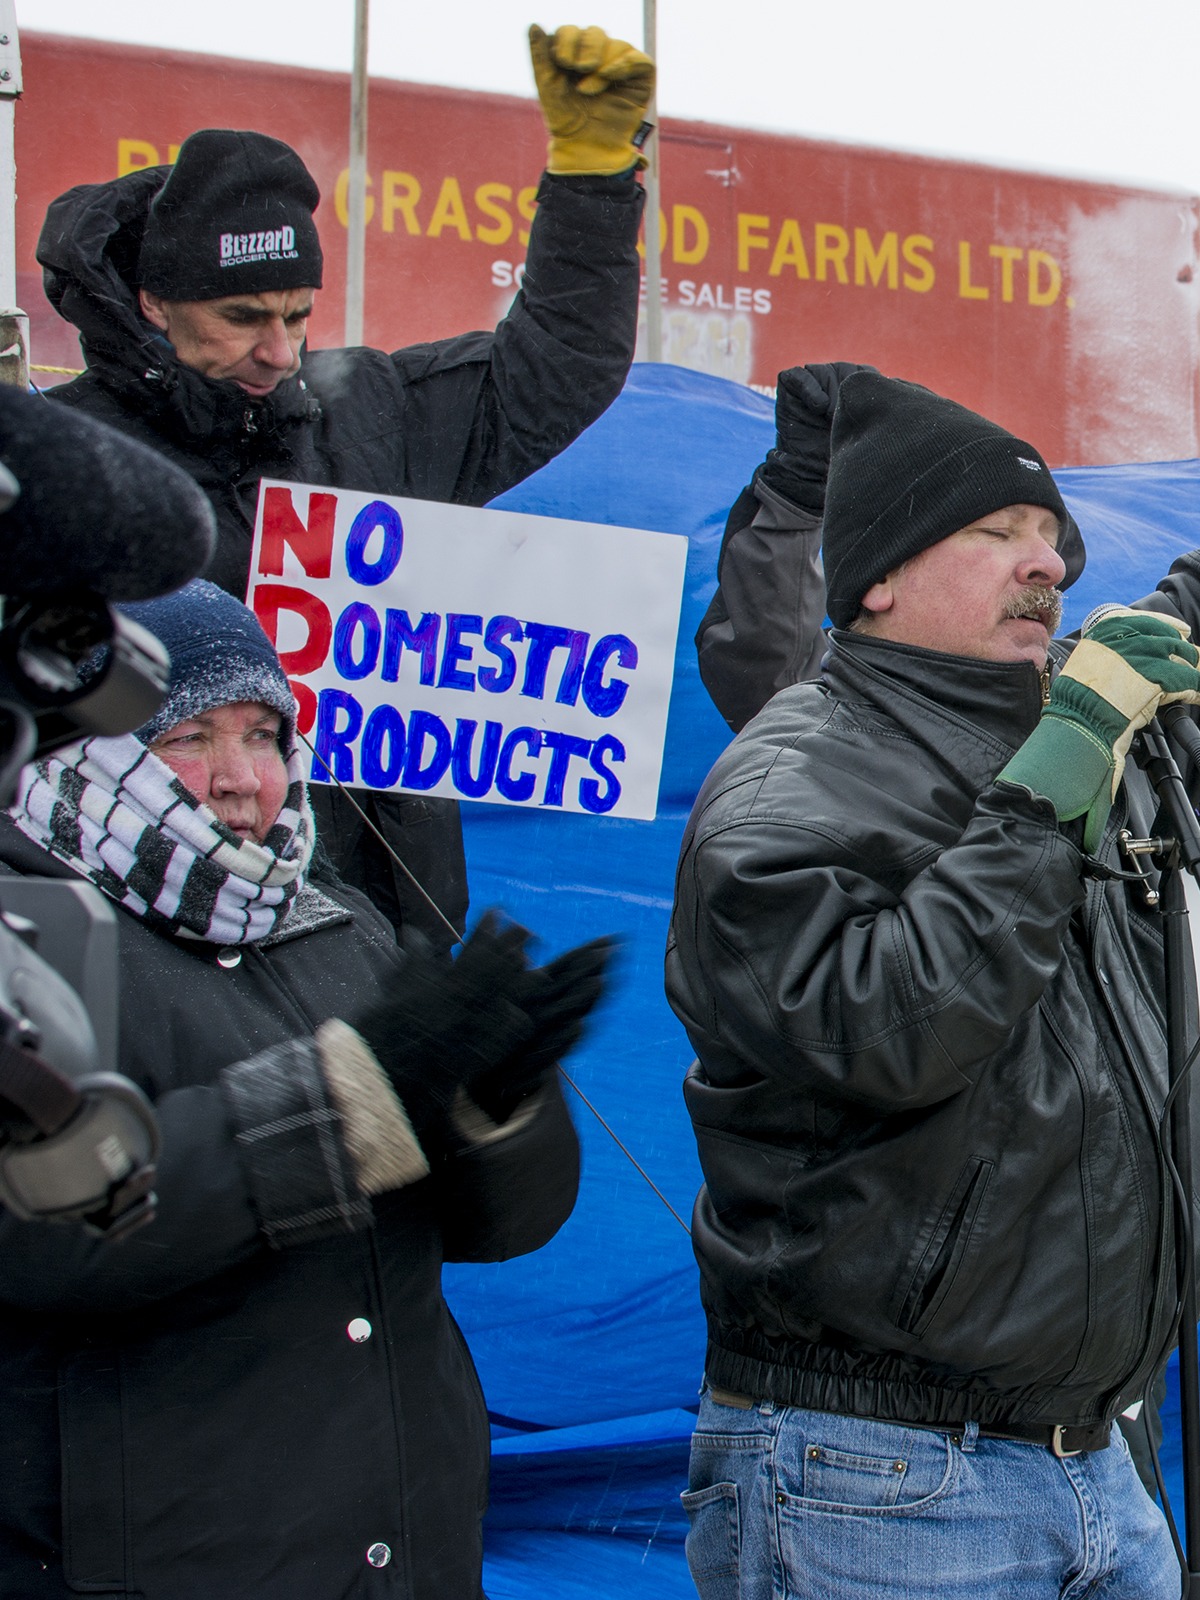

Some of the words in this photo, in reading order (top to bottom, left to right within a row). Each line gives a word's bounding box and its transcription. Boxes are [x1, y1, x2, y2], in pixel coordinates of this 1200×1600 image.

[219, 251, 267, 268] SOCCER
[269, 249, 299, 260] CLUB
[677, 279, 773, 315] SALES
[737, 212, 936, 294] FARMS
[958, 240, 1076, 310] LTD.
[257, 486, 404, 587] NO
[254, 583, 639, 719] DOMESTIC
